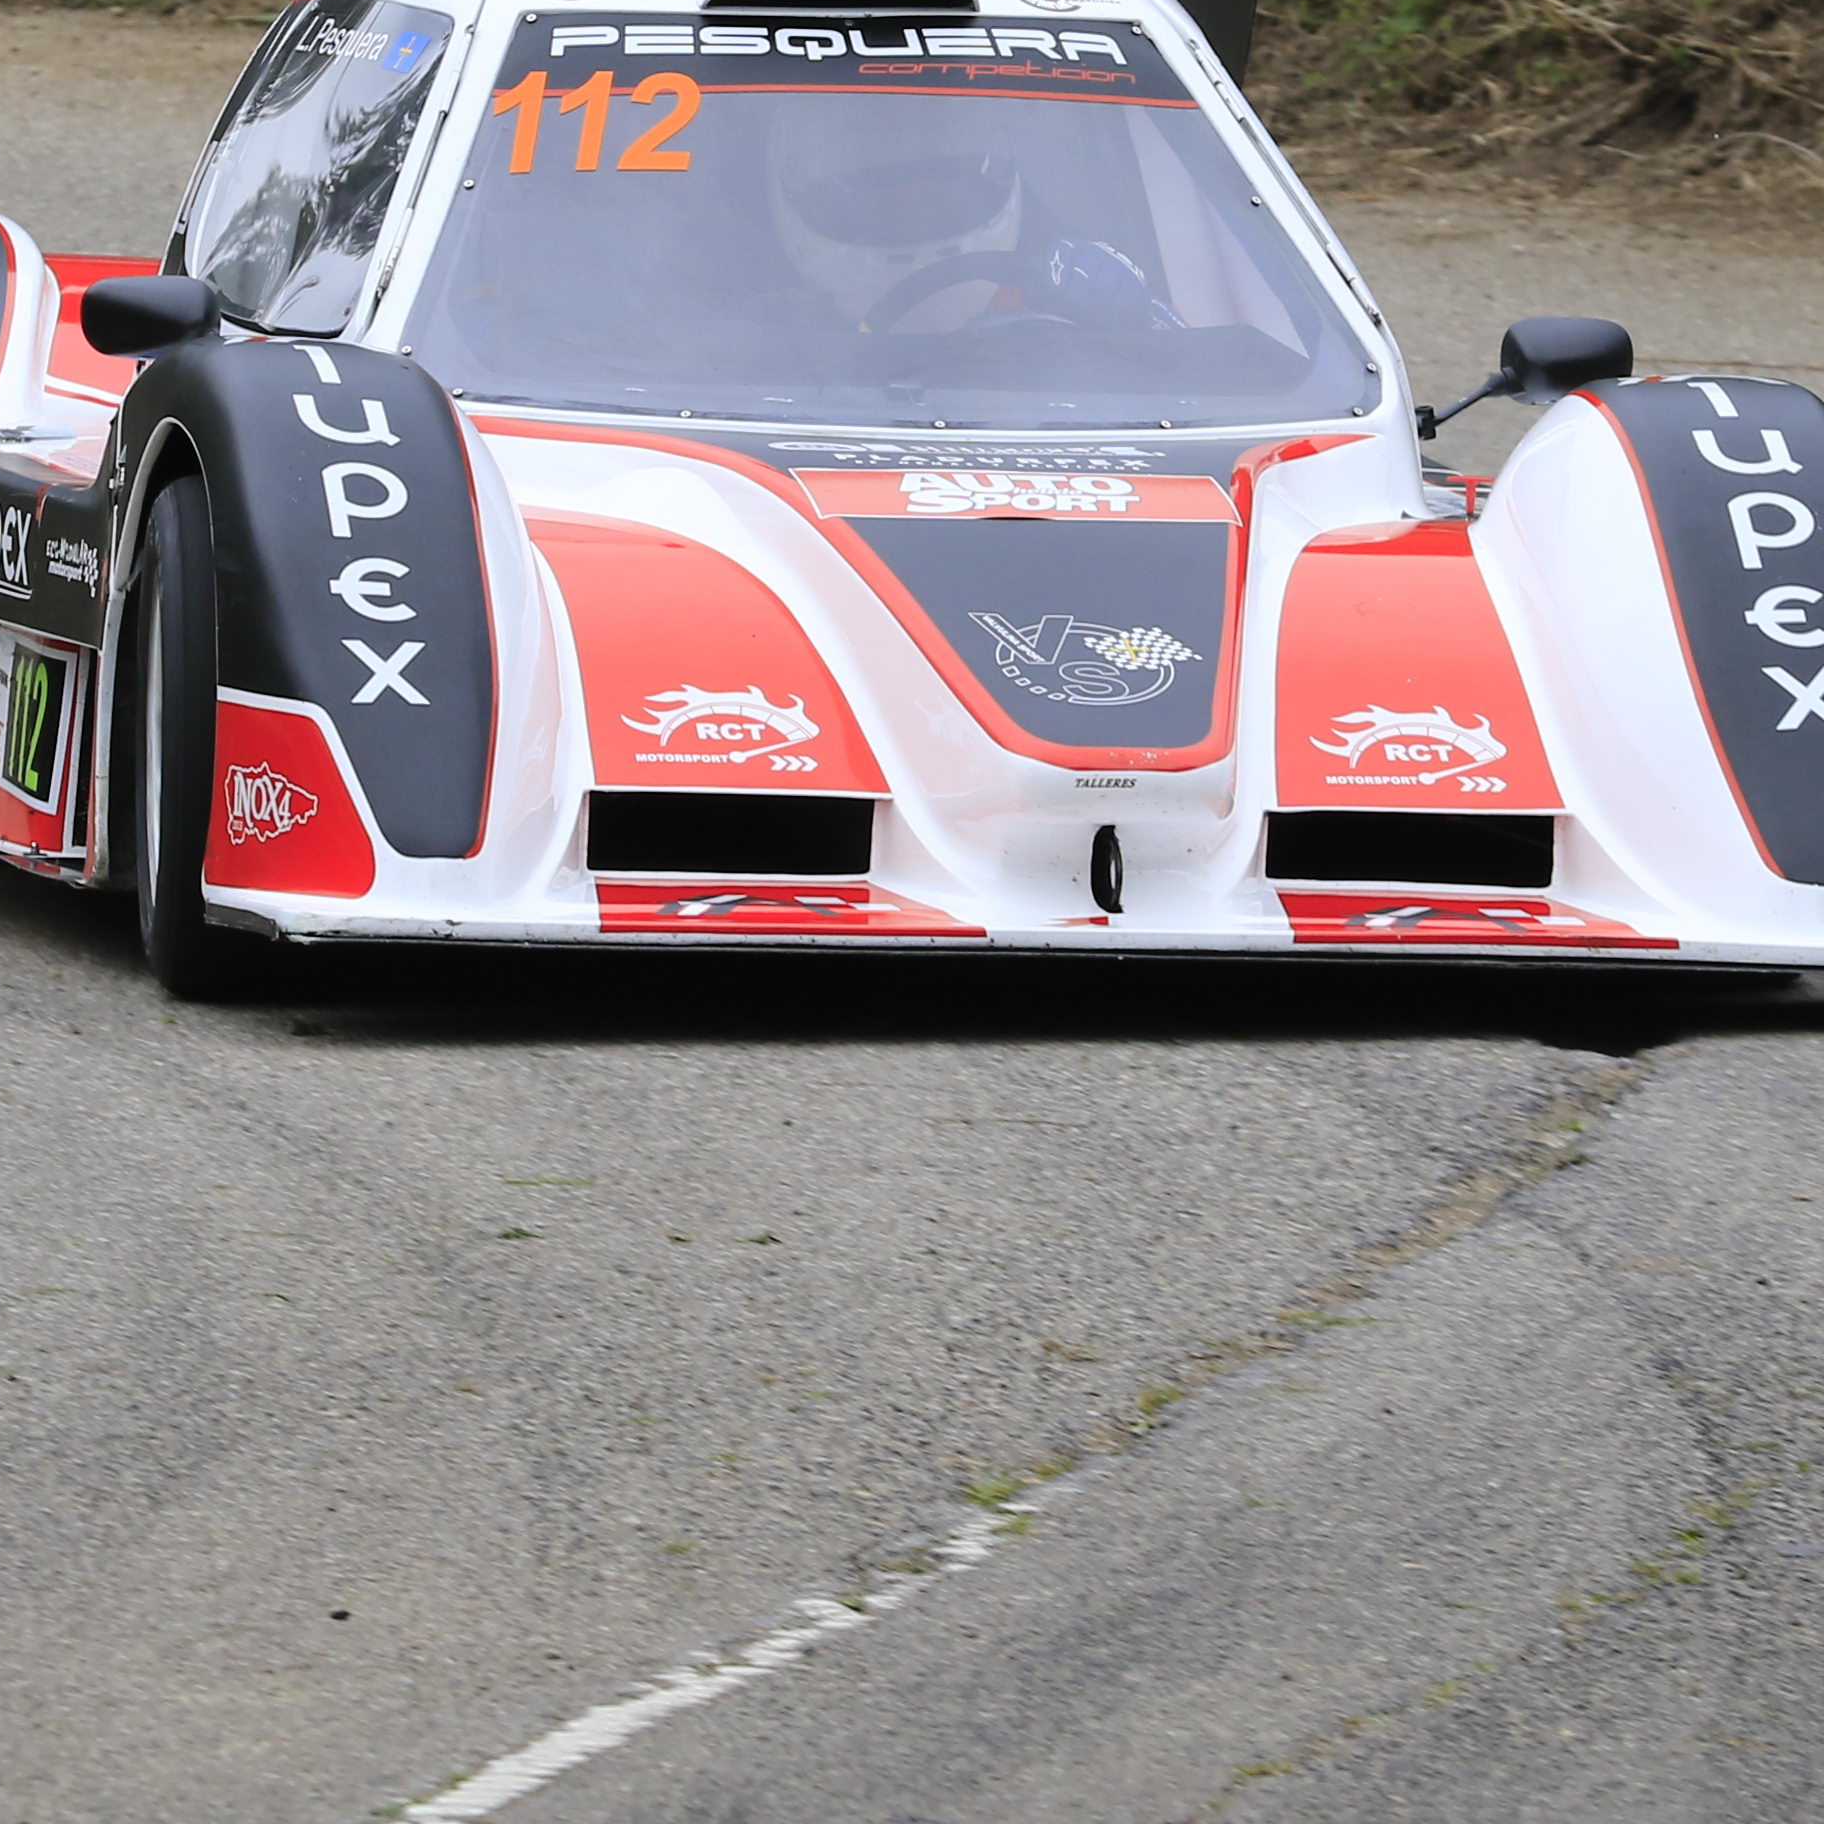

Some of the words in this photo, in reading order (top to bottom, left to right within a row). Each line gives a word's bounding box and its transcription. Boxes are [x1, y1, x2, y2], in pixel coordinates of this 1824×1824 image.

[549, 25, 1129, 65] PESQUERA
[492, 69, 702, 174] 112
[899, 472, 1134, 496] AUTO
[906, 490, 1141, 514] SPORT
[7, 655, 50, 792] 112
[695, 722, 766, 741] RCT
[635, 753, 728, 764] MOTORSPORT
[1383, 743, 1454, 762] RCT
[1075, 778, 1137, 789] TALLERES
[1326, 775, 1419, 786] MOTORSPORT
